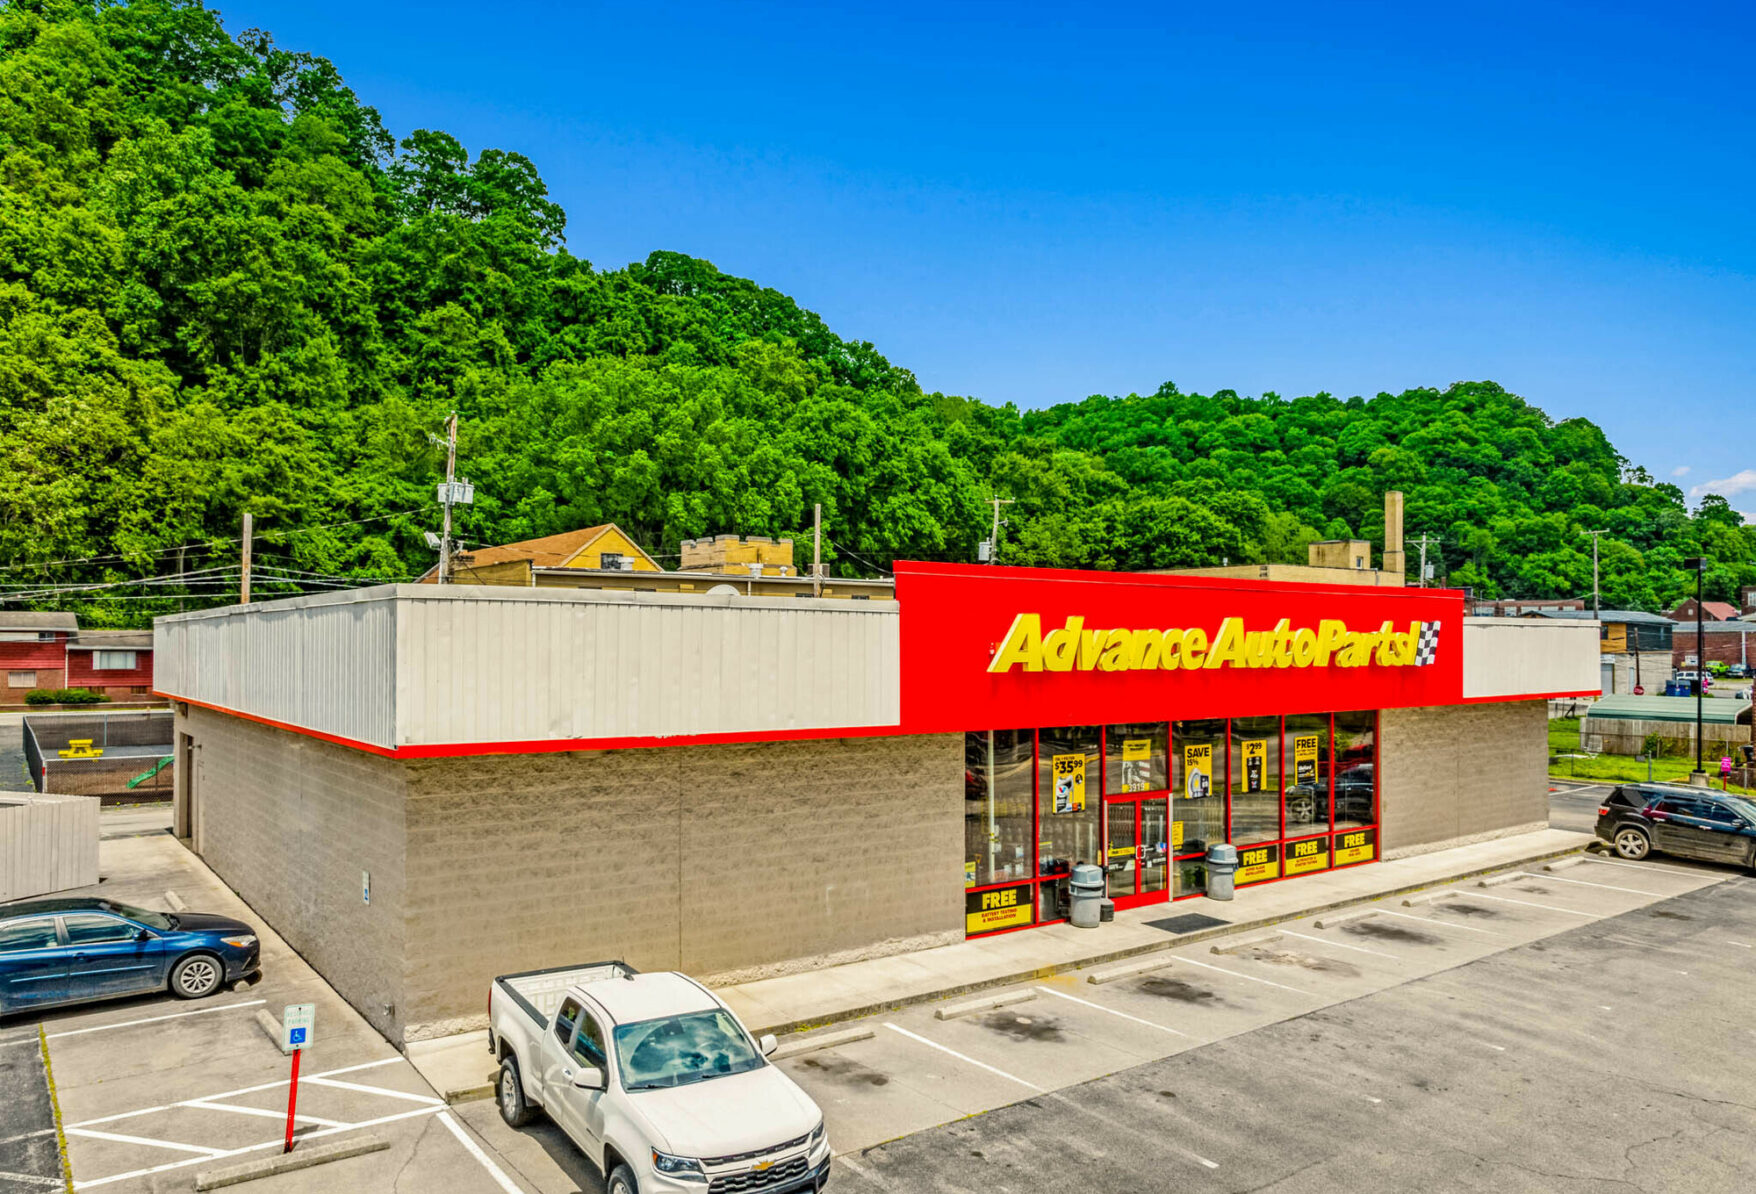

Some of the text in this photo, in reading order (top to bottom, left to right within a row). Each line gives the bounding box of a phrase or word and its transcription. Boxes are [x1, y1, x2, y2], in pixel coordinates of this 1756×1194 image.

[1296, 738, 1316, 749] FREE
[1187, 747, 1210, 758] SAVE
[1344, 832, 1366, 848] FREE
[1295, 841, 1318, 857] FREE
[1243, 849, 1268, 866] FREE
[982, 889, 1017, 910] FREE
